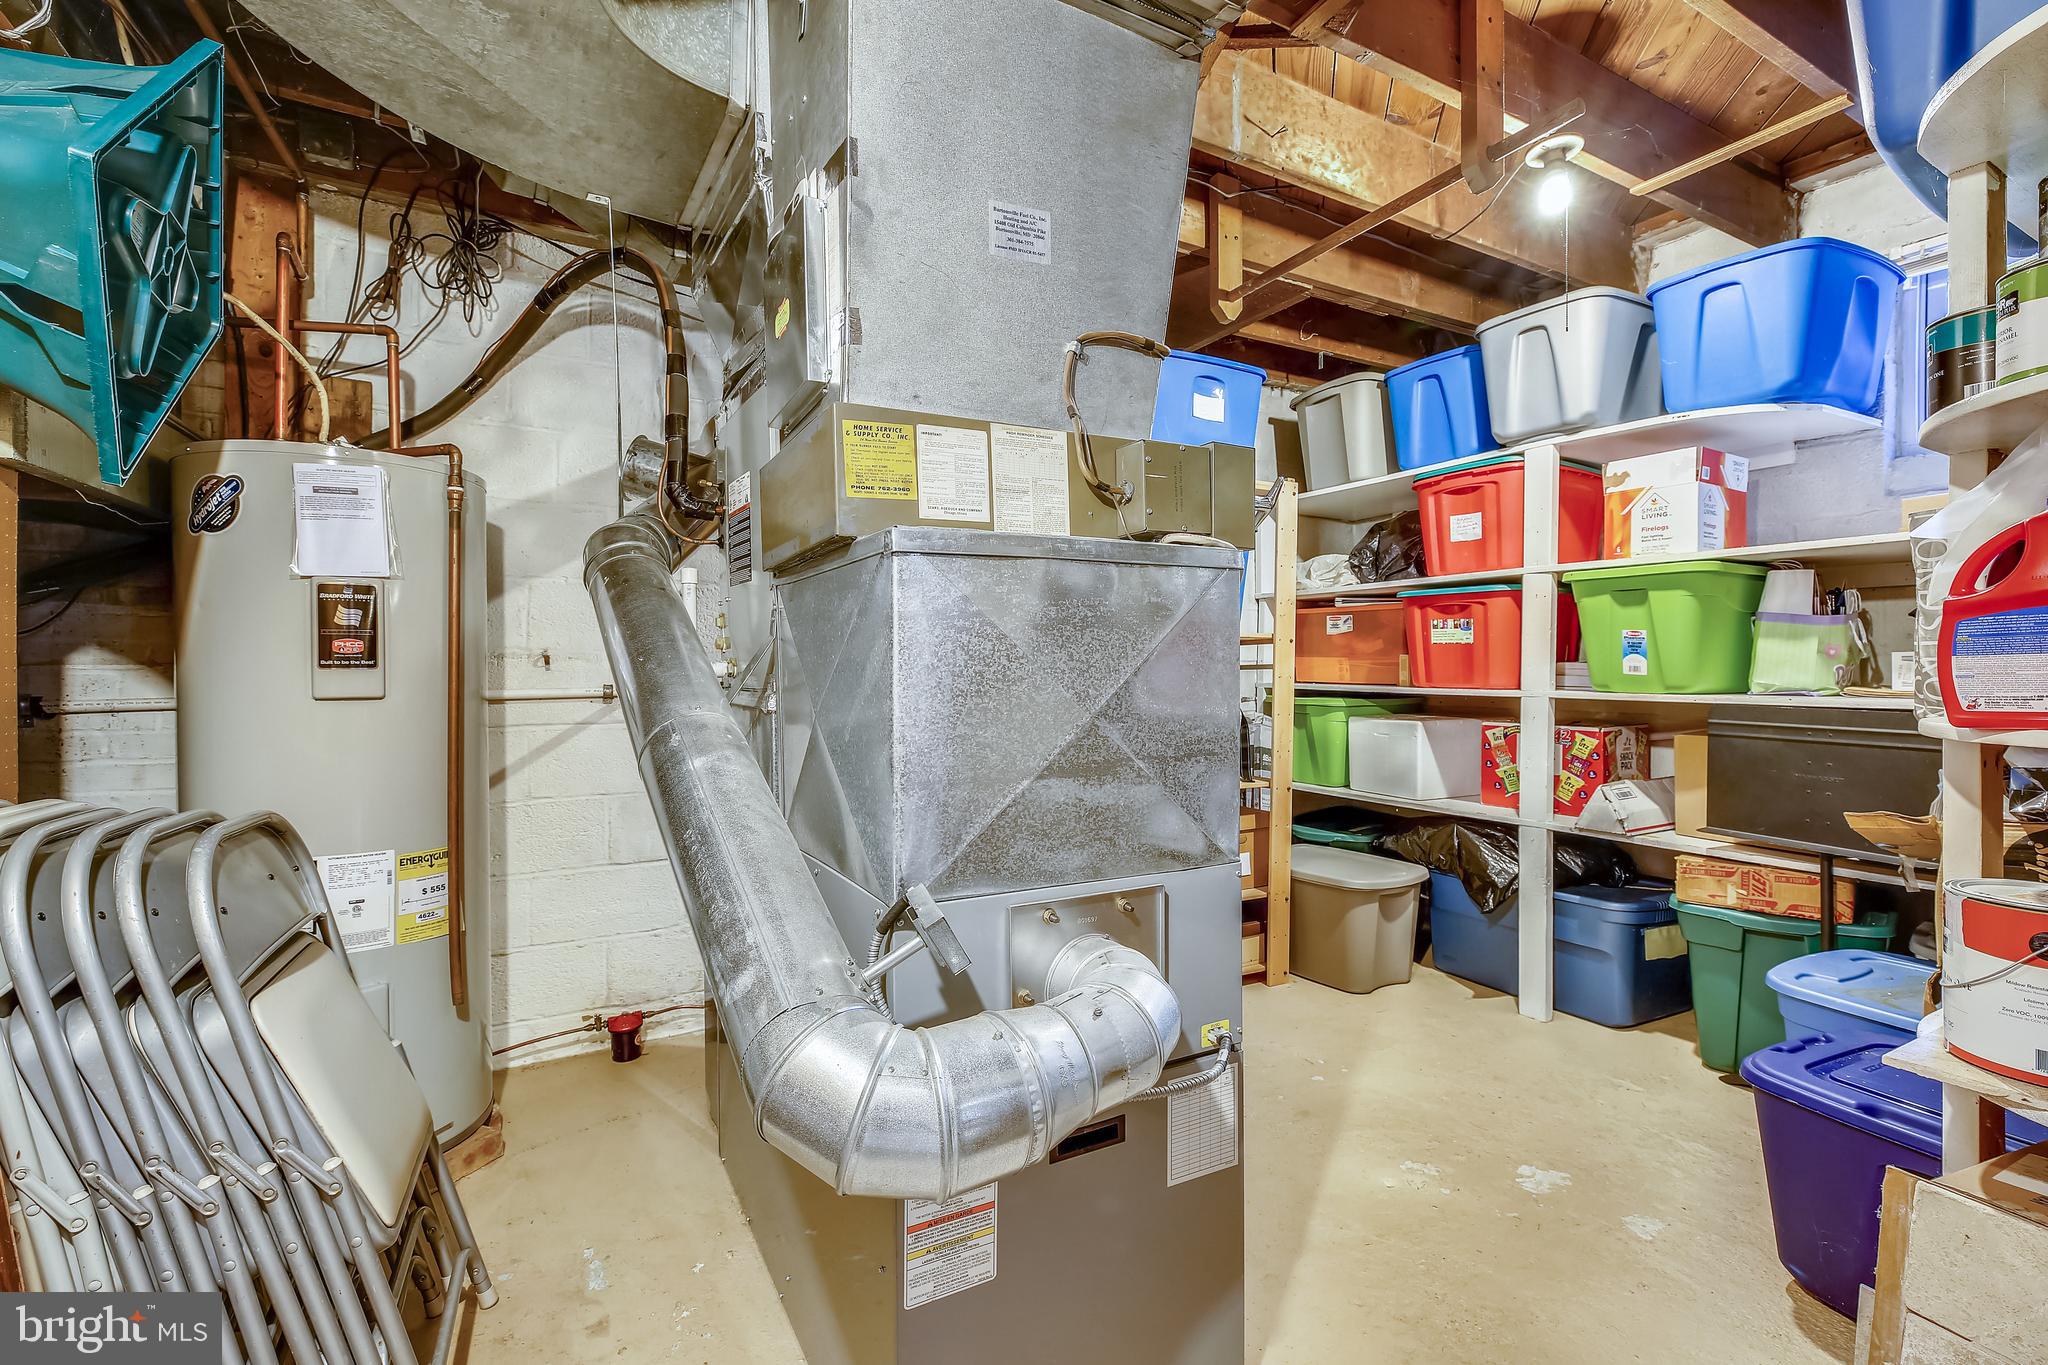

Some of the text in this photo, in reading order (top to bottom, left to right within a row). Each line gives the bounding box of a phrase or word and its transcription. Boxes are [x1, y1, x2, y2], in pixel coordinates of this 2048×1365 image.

[876, 425, 903, 433] SERVICE
[853, 430, 879, 438] SUPPLY
[881, 432, 895, 440] CO.,
[193, 491, 222, 526] Hydrojet
[1641, 505, 1668, 514] SMART
[1641, 511, 1668, 520] LIVING
[1641, 524, 1669, 533] Firelogs
[354, 593, 376, 601] WHITE
[1619, 752, 1634, 762] SNACK
[1620, 761, 1633, 770] PACK
[430, 884, 447, 893] 555
[417, 911, 435, 920] 4622
[2005, 979, 2026, 988] Mildew
[2023, 997, 2045, 1006] Lifetime
[2001, 1006, 2015, 1014] Zero
[2015, 1009, 2033, 1018] VOC,
[933, 1208, 975, 1226] MISE EN GARDE
[932, 1234, 974, 1252] AVERTISSEMENT
